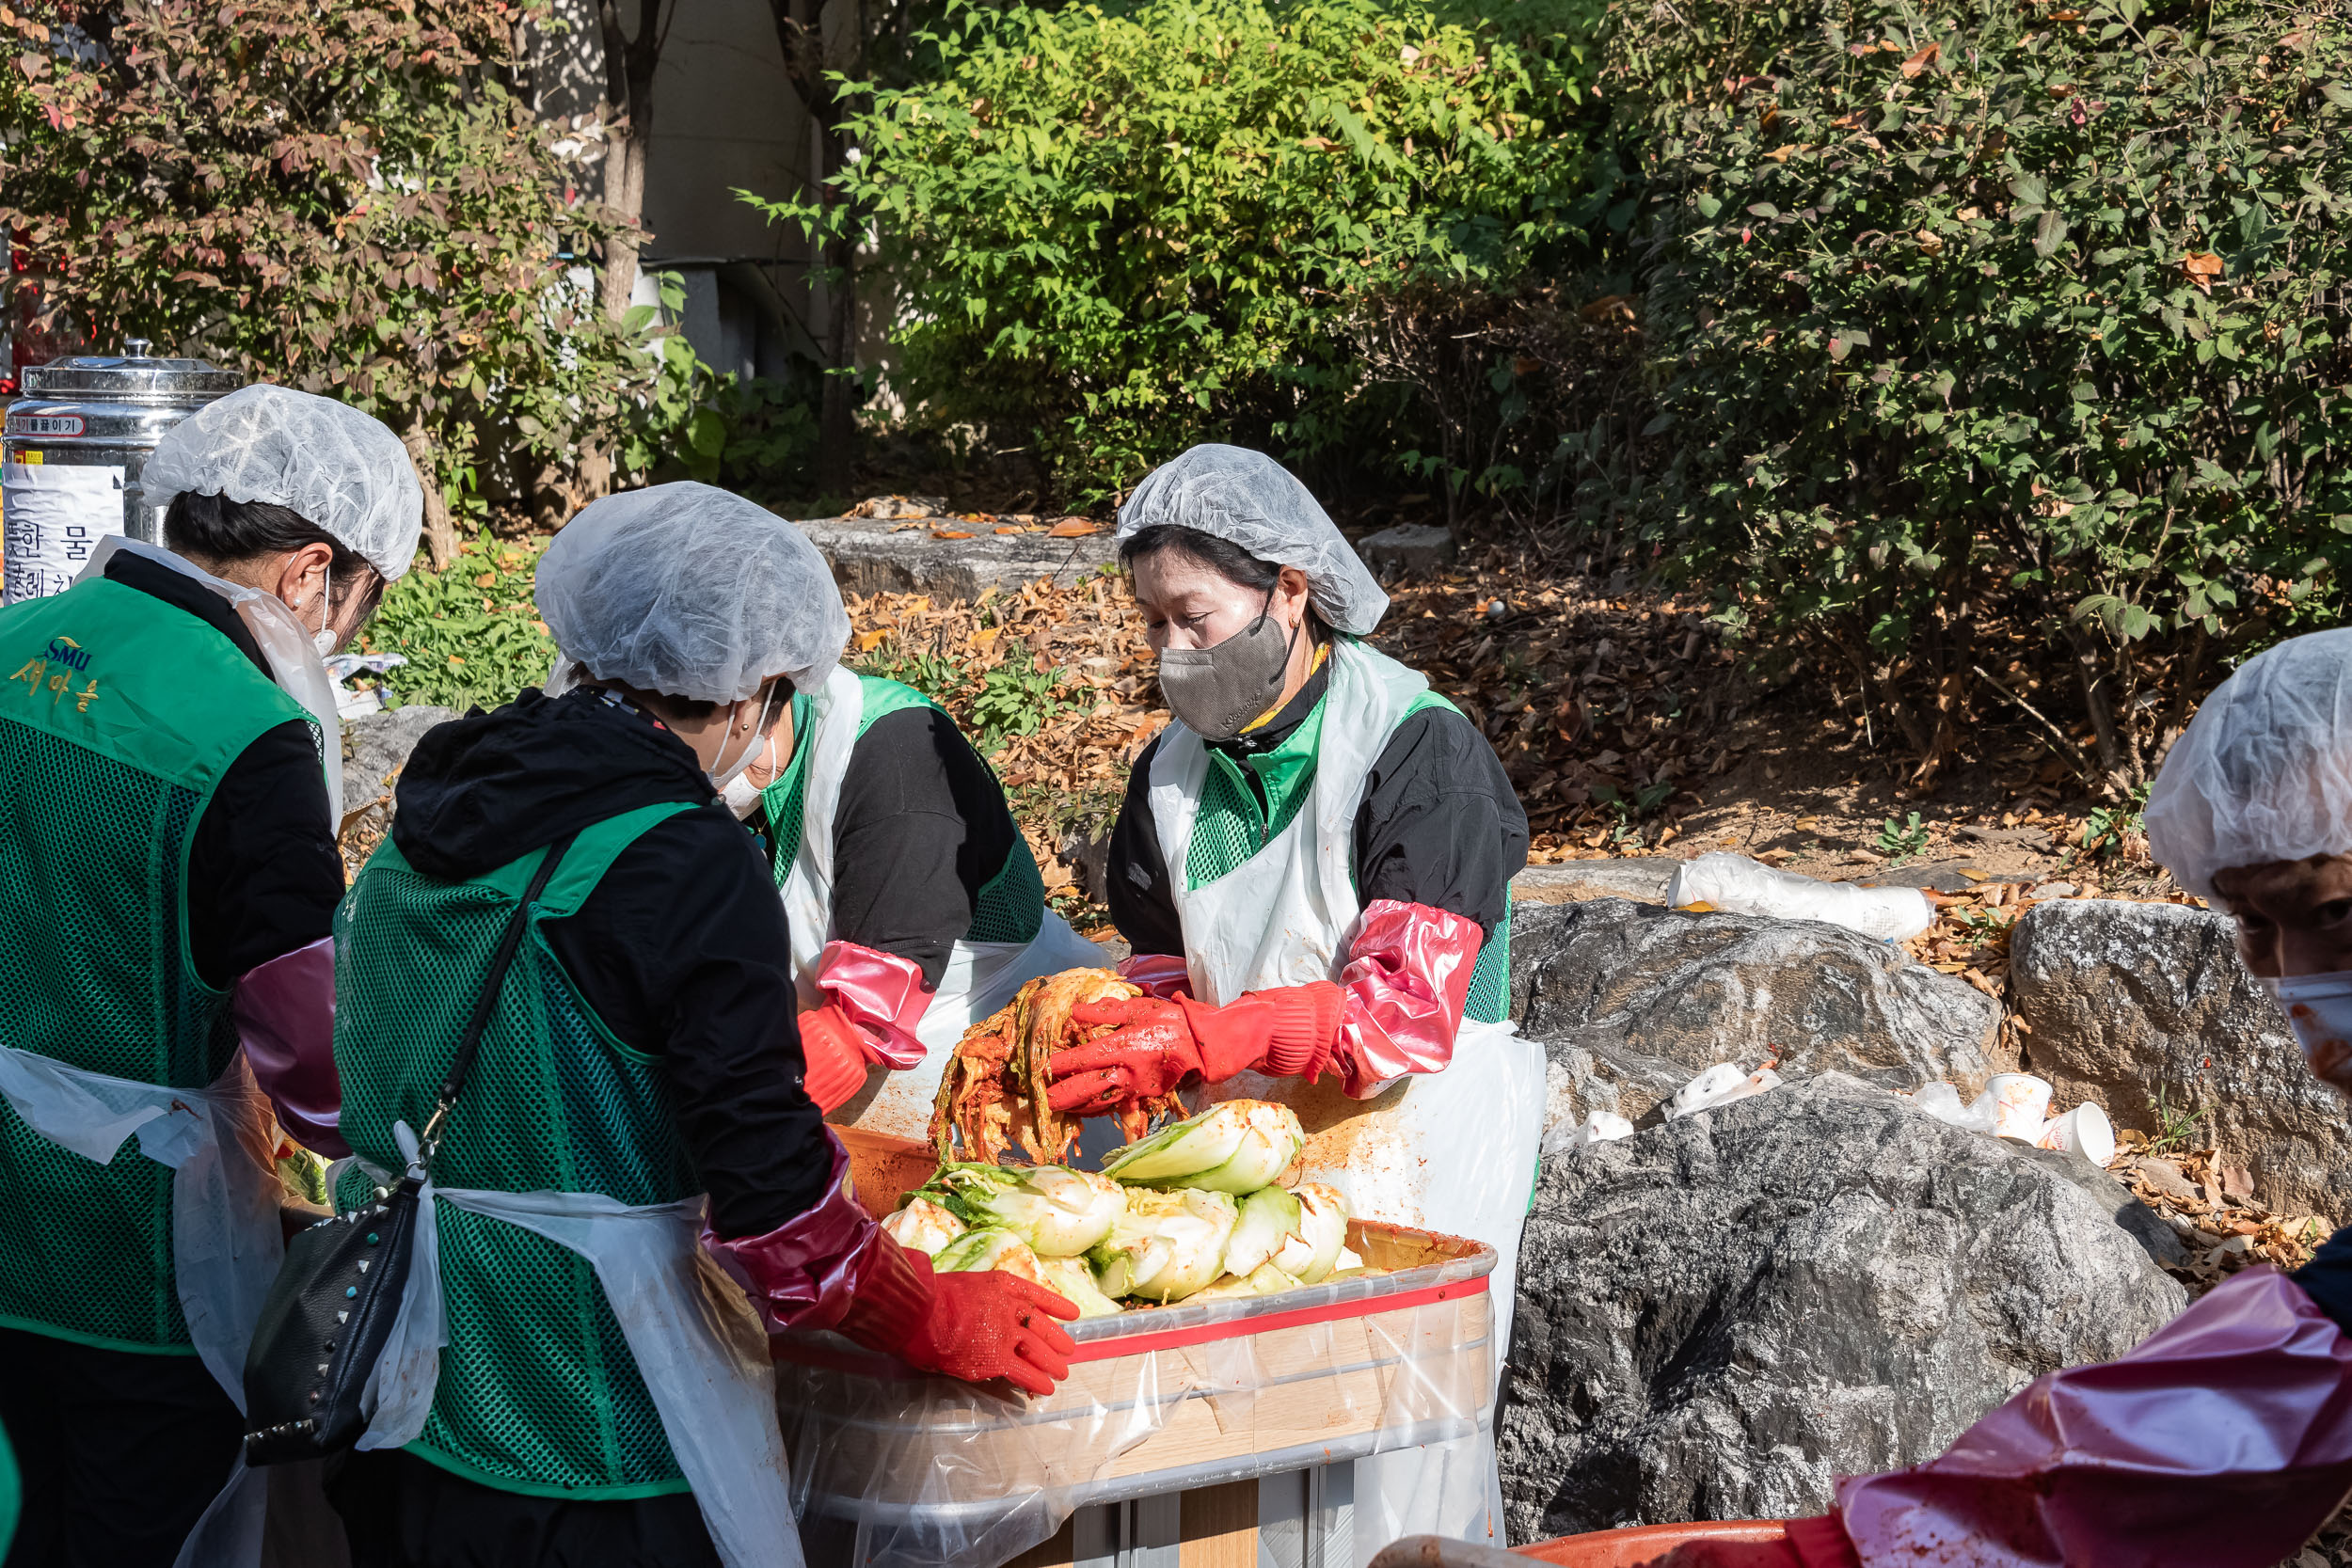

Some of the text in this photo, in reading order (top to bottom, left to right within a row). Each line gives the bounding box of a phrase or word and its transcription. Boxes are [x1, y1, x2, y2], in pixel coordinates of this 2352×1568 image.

[60, 526, 93, 561] 물
[44, 639, 92, 671] SMU
[9, 657, 99, 713] 새마을
